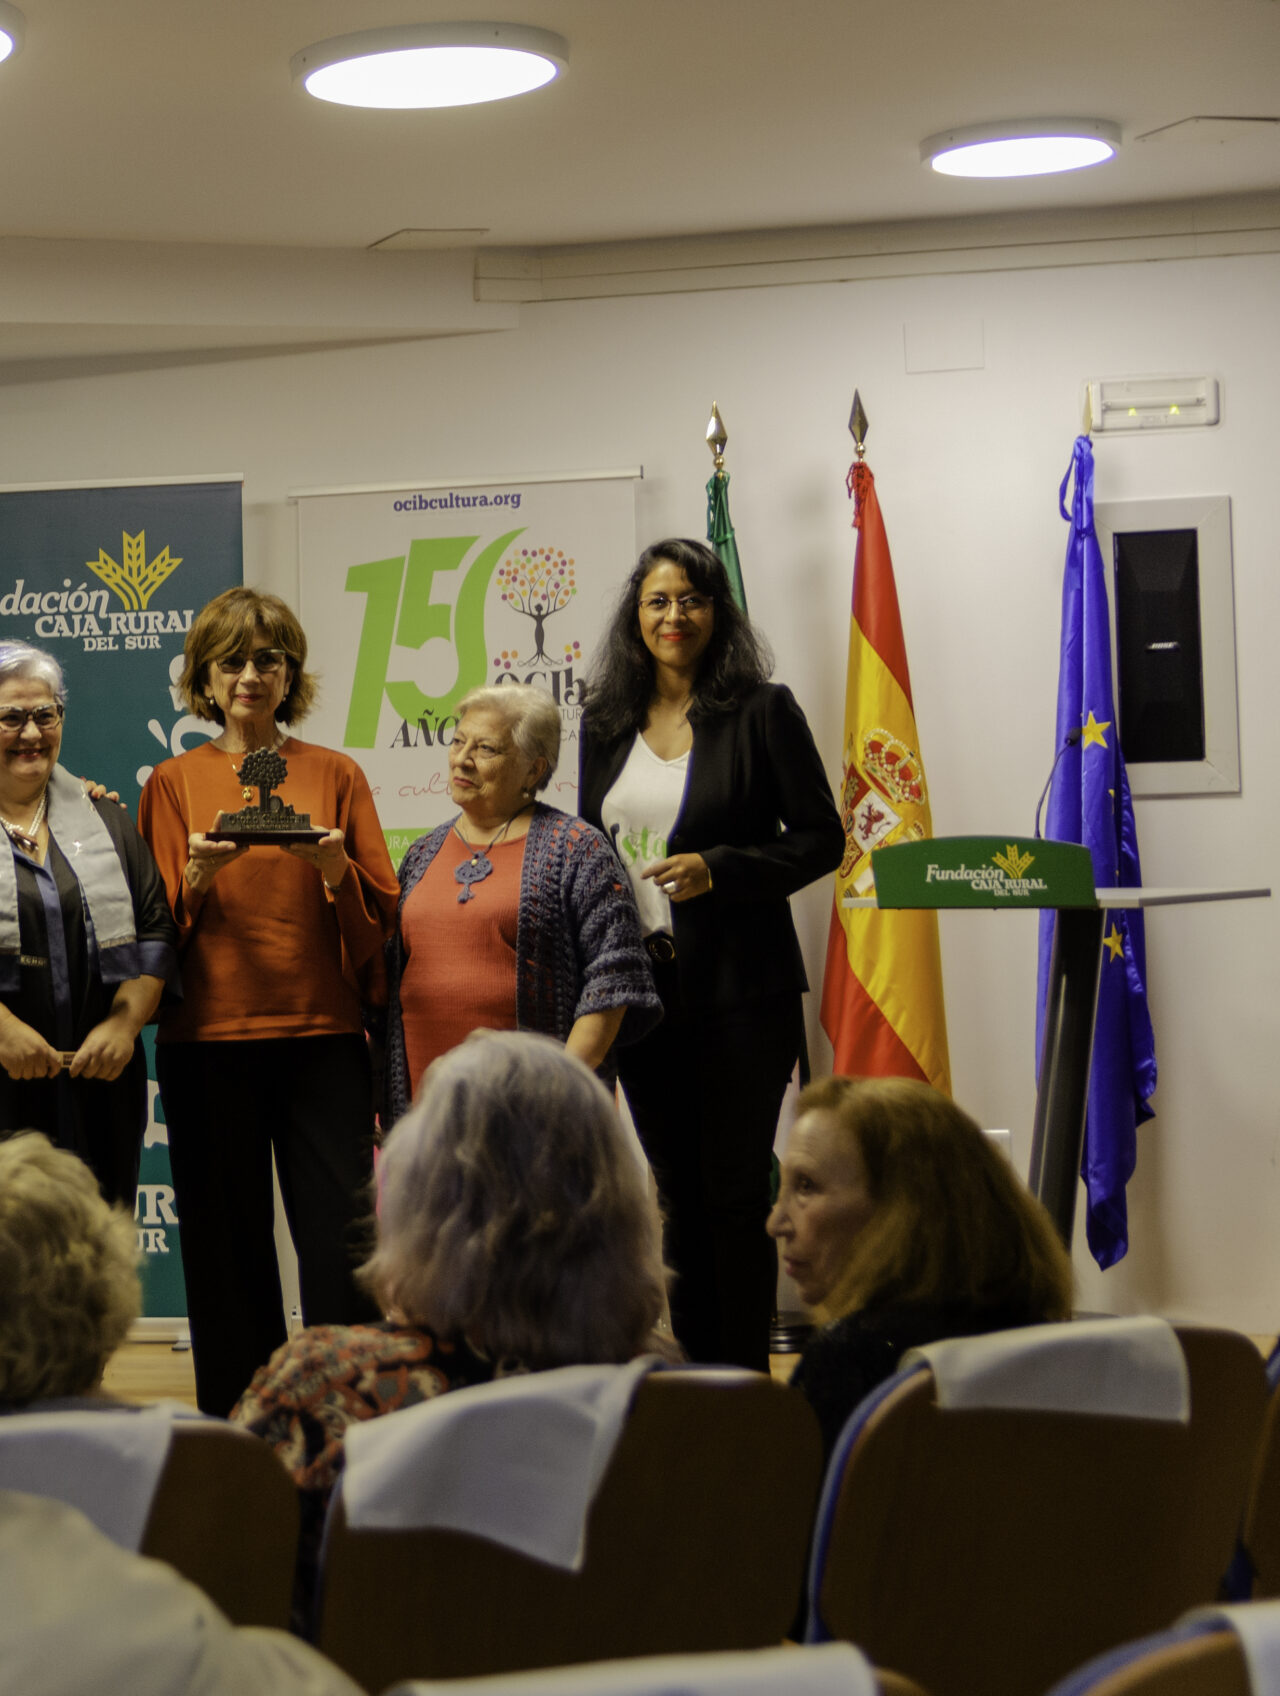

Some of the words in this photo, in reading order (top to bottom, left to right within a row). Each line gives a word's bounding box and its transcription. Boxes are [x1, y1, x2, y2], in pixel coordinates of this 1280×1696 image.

[393, 492, 522, 512] ocibcultura.org
[35, 613, 103, 639] CAJA
[83, 636, 119, 652] DEL
[125, 635, 162, 650] SUR
[343, 526, 529, 749] 15
[389, 708, 460, 749] AÑO
[925, 864, 1005, 883] Fundación
[971, 879, 1003, 890] CAJA
[1004, 878, 1048, 889] RURAL
[993, 888, 1011, 897] DEL
